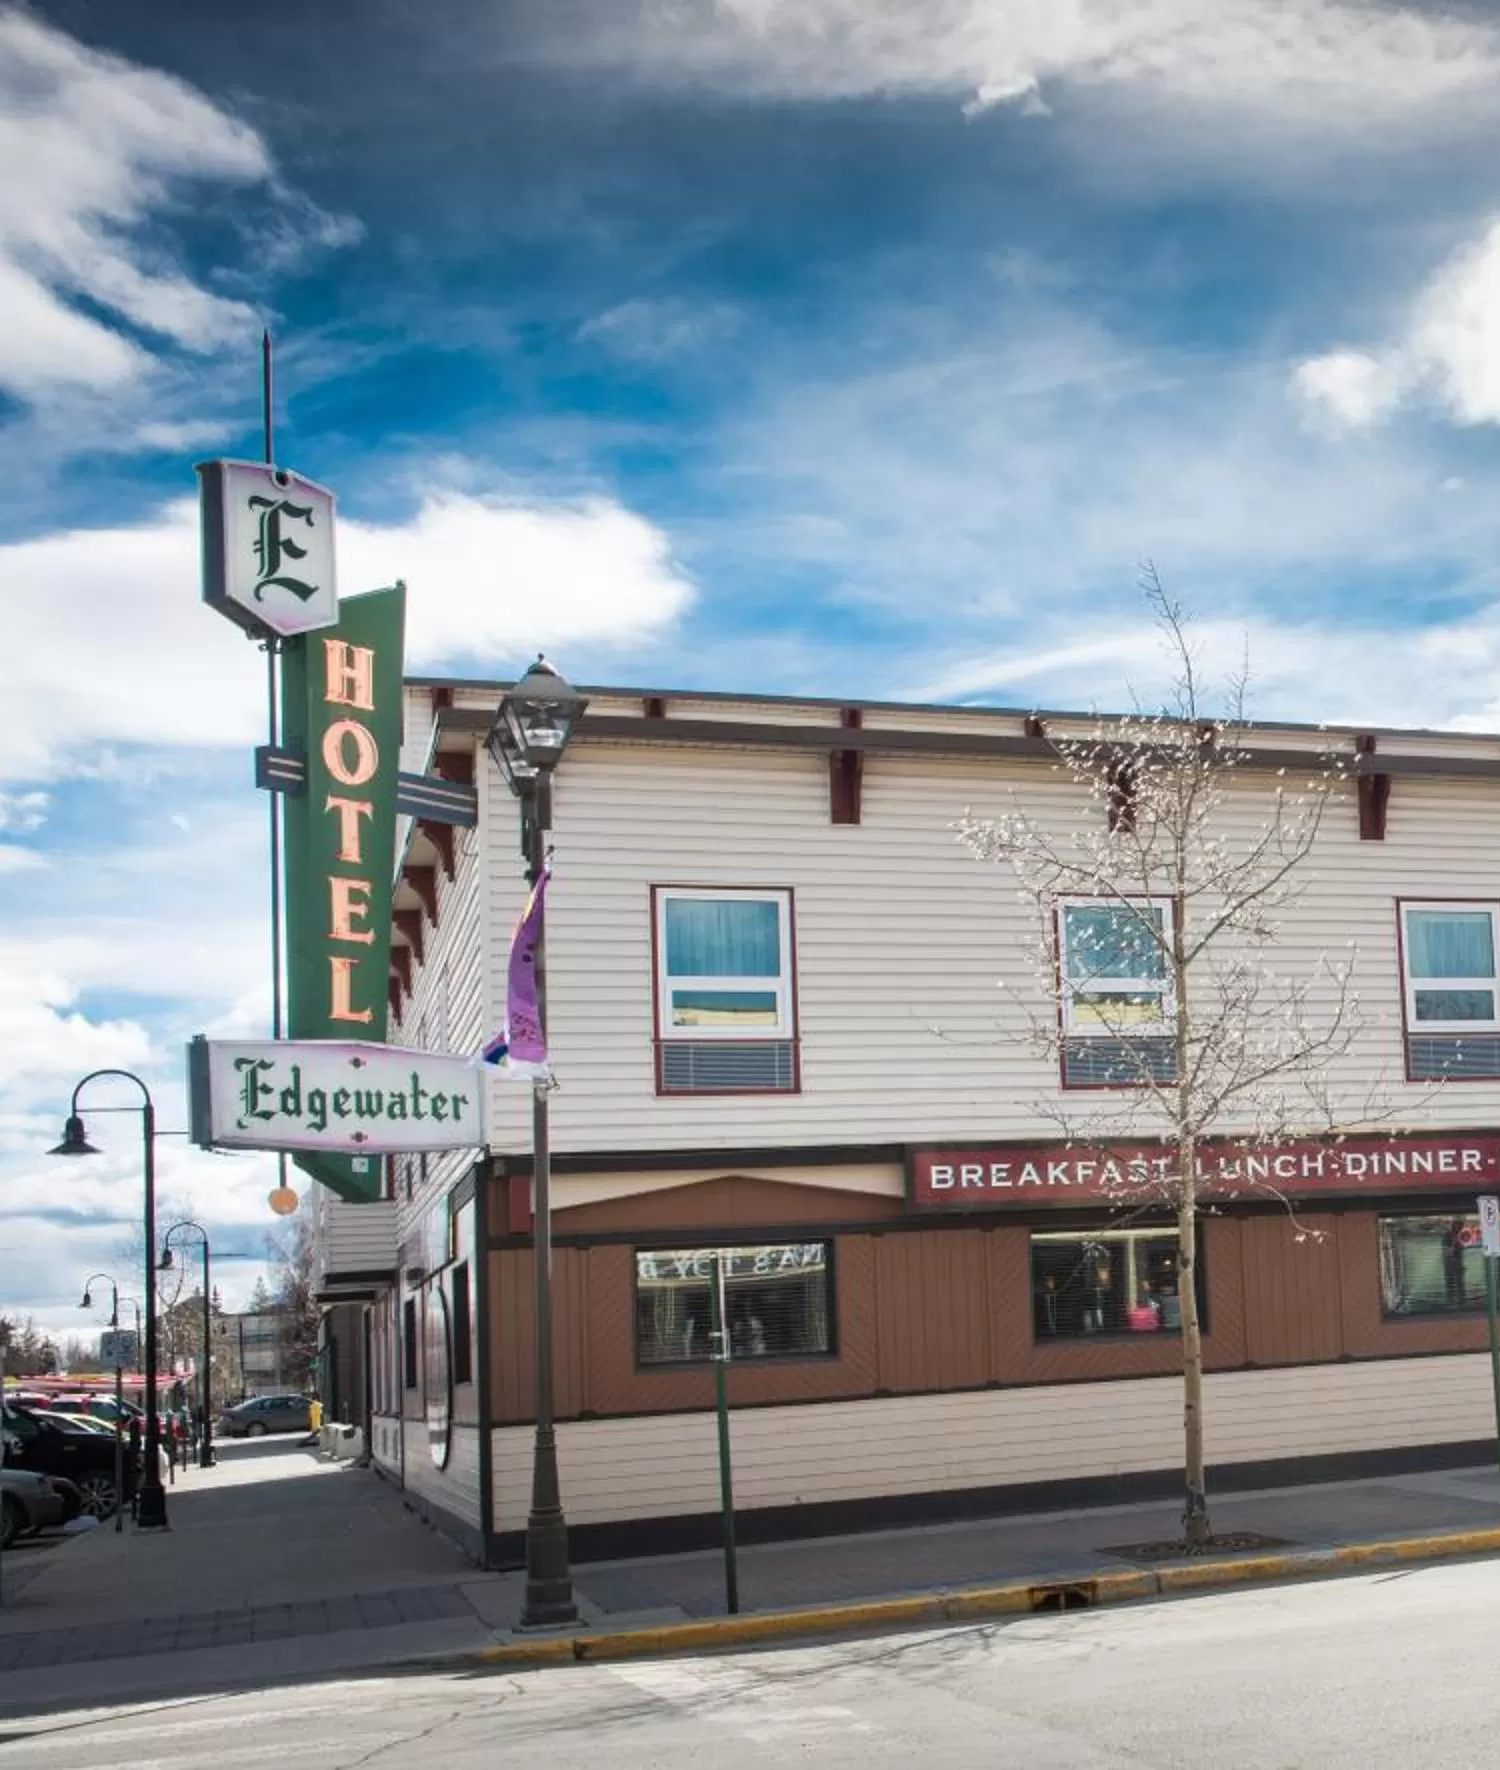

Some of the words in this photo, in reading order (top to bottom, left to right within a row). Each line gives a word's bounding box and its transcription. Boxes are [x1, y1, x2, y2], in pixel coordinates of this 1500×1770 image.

[248, 494, 320, 603] E
[322, 639, 380, 1024] HOTEL
[234, 1056, 469, 1132] Edgewater
